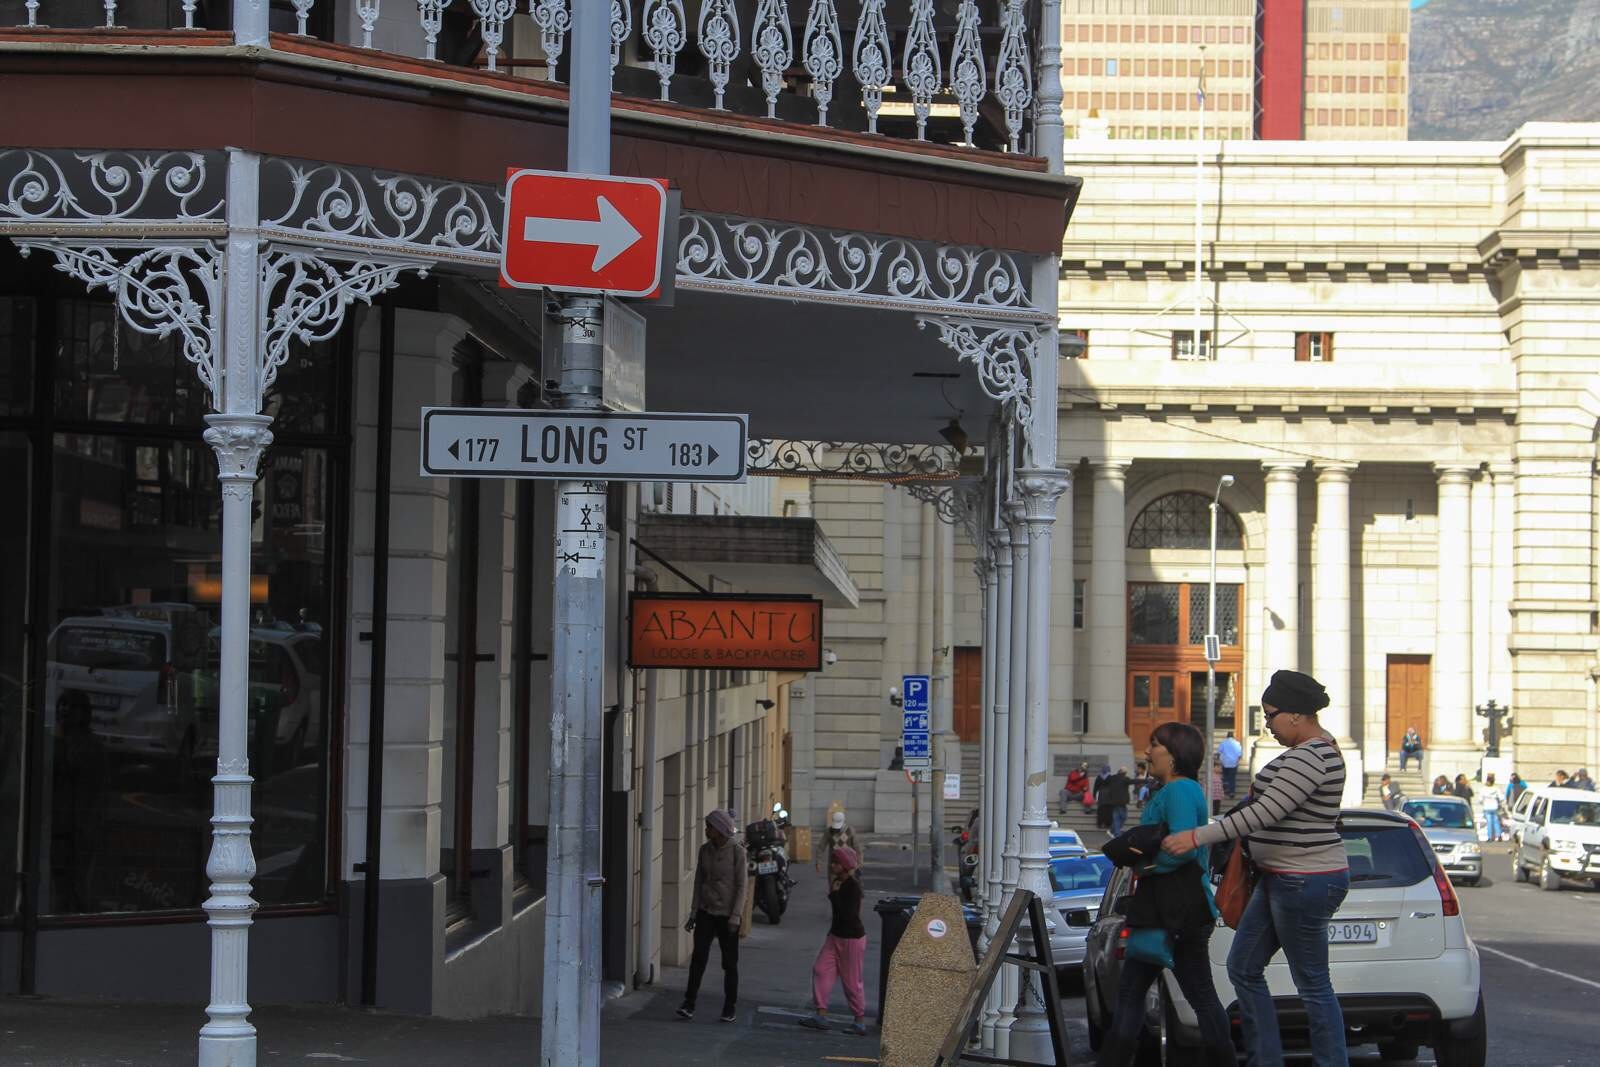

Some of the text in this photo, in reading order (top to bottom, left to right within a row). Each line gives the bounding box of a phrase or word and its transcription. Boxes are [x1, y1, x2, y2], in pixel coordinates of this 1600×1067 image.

[465, 438, 500, 462] 177
[520, 423, 648, 465] LONG ST
[669, 442, 702, 467] 183
[639, 609, 818, 643] ABANTU
[653, 646, 697, 661] LODGE
[703, 648, 713, 660] &
[909, 681, 922, 697] P
[904, 699, 917, 707] 120
